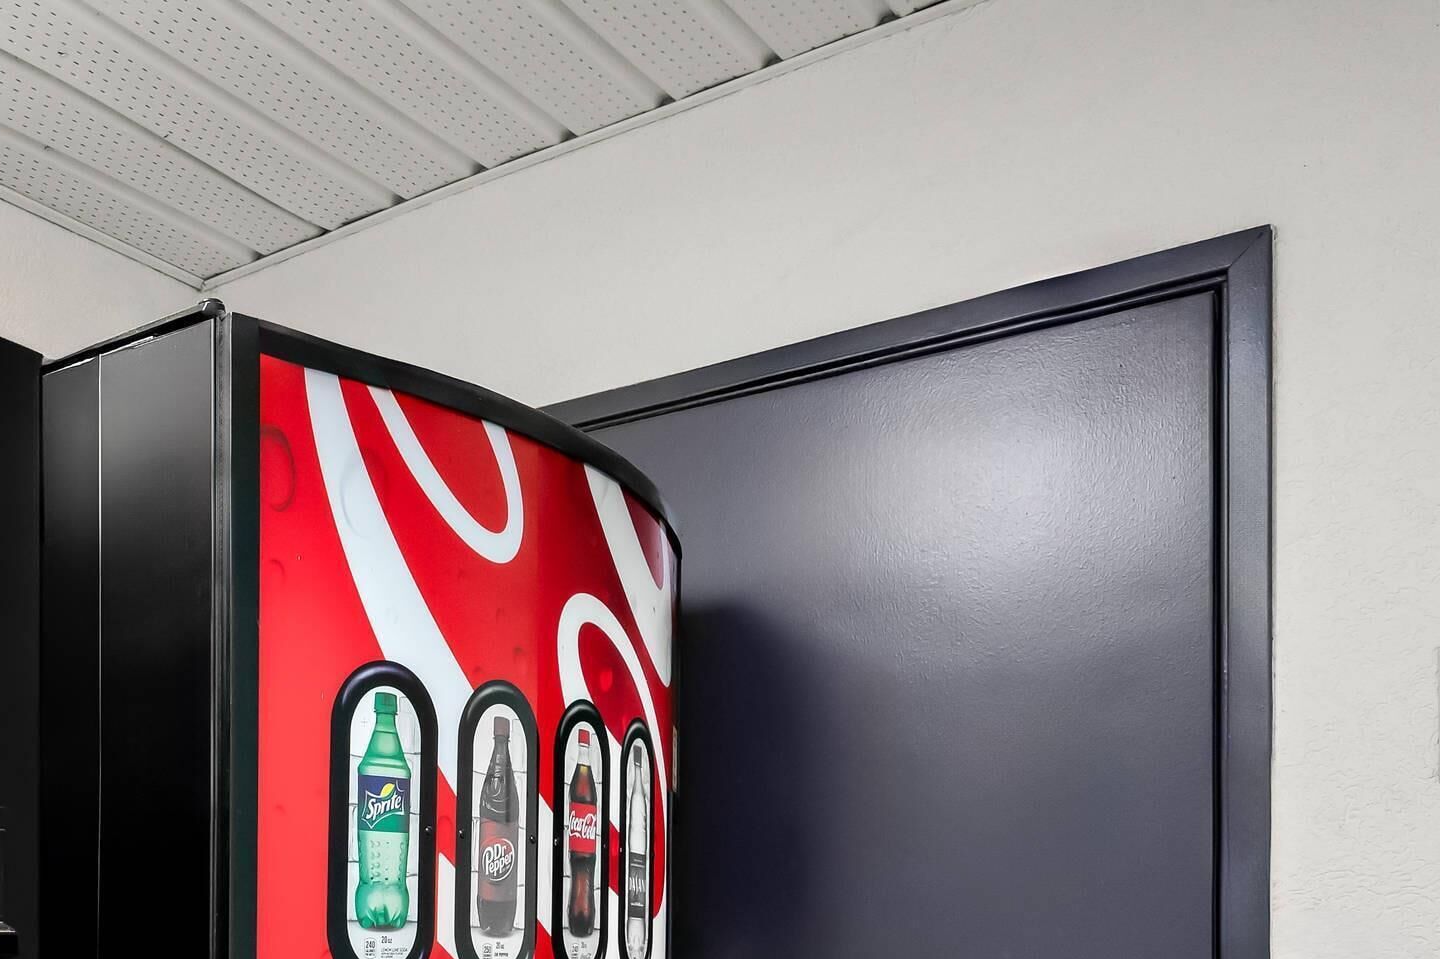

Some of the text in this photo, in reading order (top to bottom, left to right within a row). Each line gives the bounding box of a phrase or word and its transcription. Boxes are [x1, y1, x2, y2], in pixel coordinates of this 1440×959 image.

[366, 791, 402, 820] Sprite
[485, 846, 513, 876] Pepper
[494, 843, 507, 860] Dr
